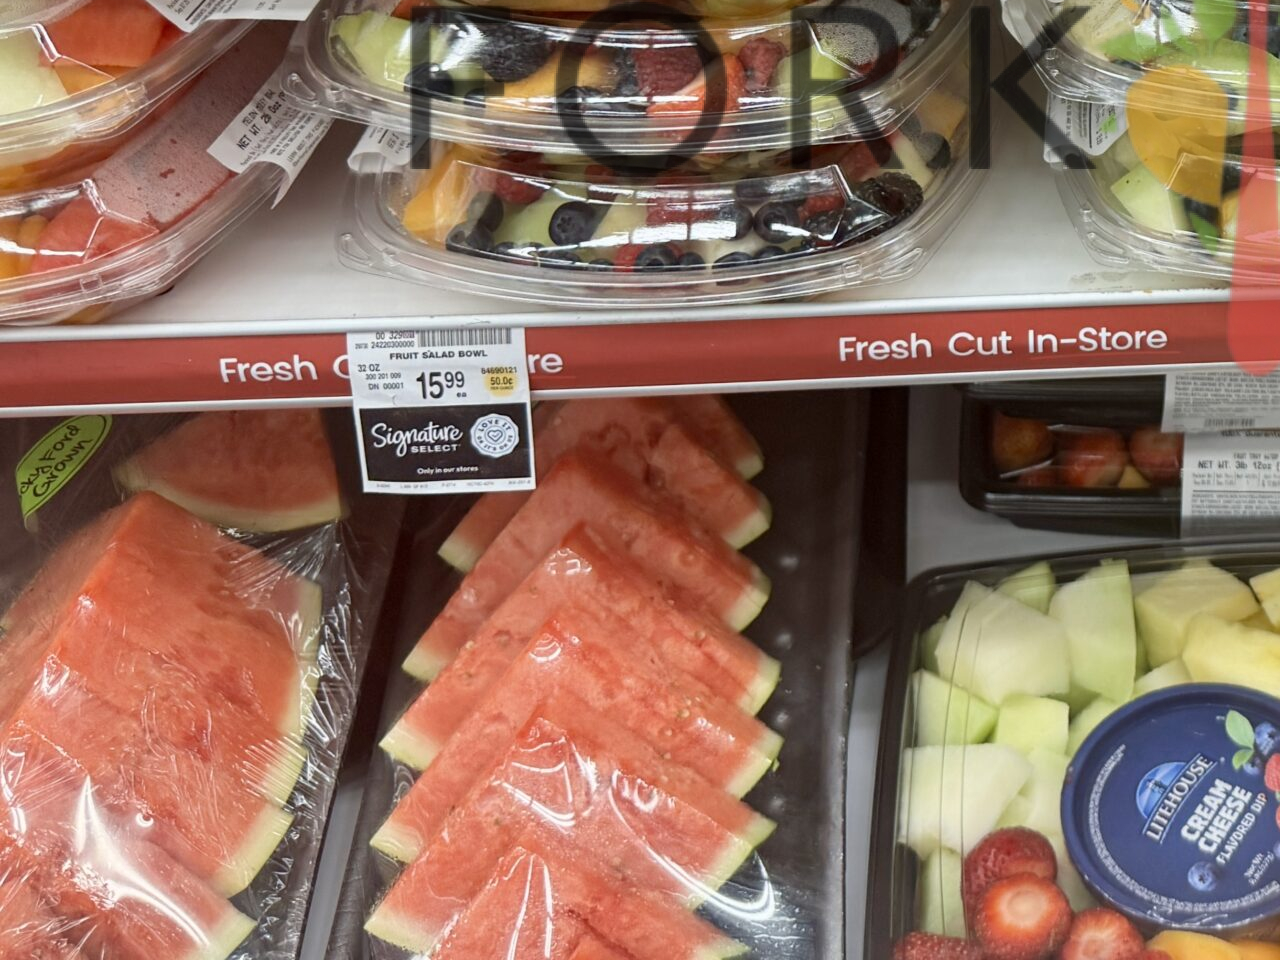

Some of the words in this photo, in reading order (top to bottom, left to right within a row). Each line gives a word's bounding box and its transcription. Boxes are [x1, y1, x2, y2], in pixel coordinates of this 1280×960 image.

[389, 352, 419, 360] FRUIT
[422, 351, 455, 359] SALAD
[458, 350, 488, 358] BOWL
[838, 332, 932, 362] Fresh
[948, 330, 1012, 357] Cut
[1028, 327, 1167, 354] In-Store
[219, 354, 318, 383] Fresh
[358, 364, 366, 372] 32
[368, 363, 380, 371] OZ
[371, 421, 464, 458] Signature
[479, 419, 499, 431] LOVE
[20, 464, 52, 494] cky
[39, 424, 80, 461] Ford
[410, 445, 458, 453] SELECT
[1198, 460, 1213, 469] NET
[33, 438, 94, 497] Grown
[417, 467, 434, 475] Only
[1146, 755, 1214, 841] LITEHOUSE
[1180, 778, 1233, 842] CREAM
[1197, 785, 1253, 854] CHEESE
[1215, 811, 1256, 865] FLAVORED
[1252, 792, 1268, 813] DIP
